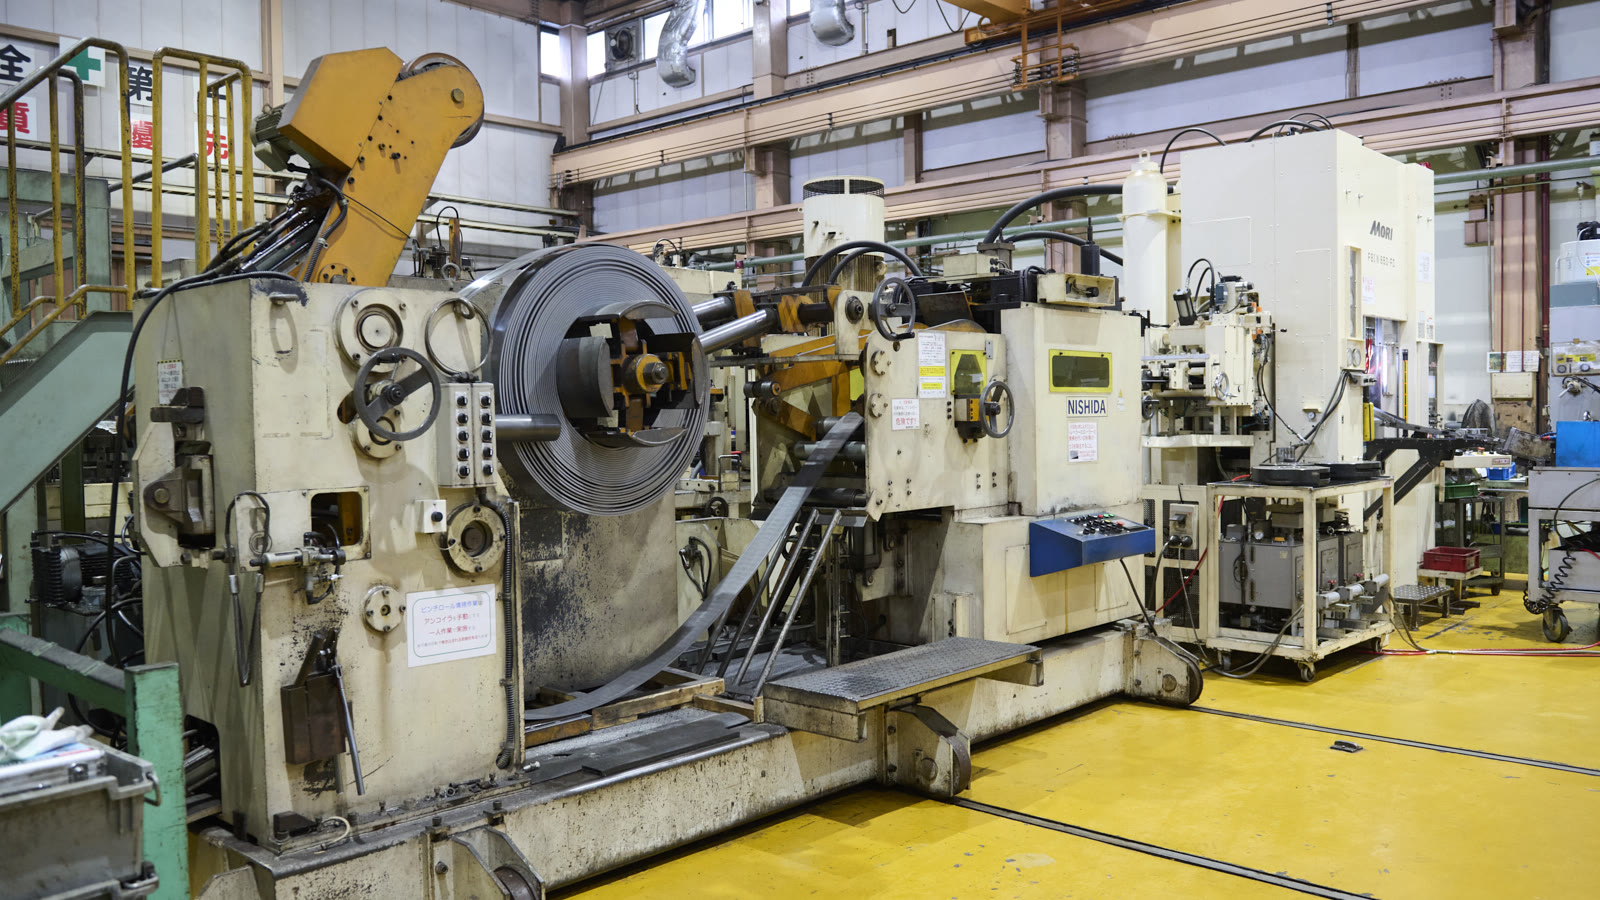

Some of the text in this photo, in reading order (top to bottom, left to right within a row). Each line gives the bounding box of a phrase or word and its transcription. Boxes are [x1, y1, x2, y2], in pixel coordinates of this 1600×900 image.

[0, 44, 31, 82] 全
[0, 102, 30, 134] 質
[1369, 220, 1393, 241] MORI
[1067, 399, 1106, 415] NISHIDA
